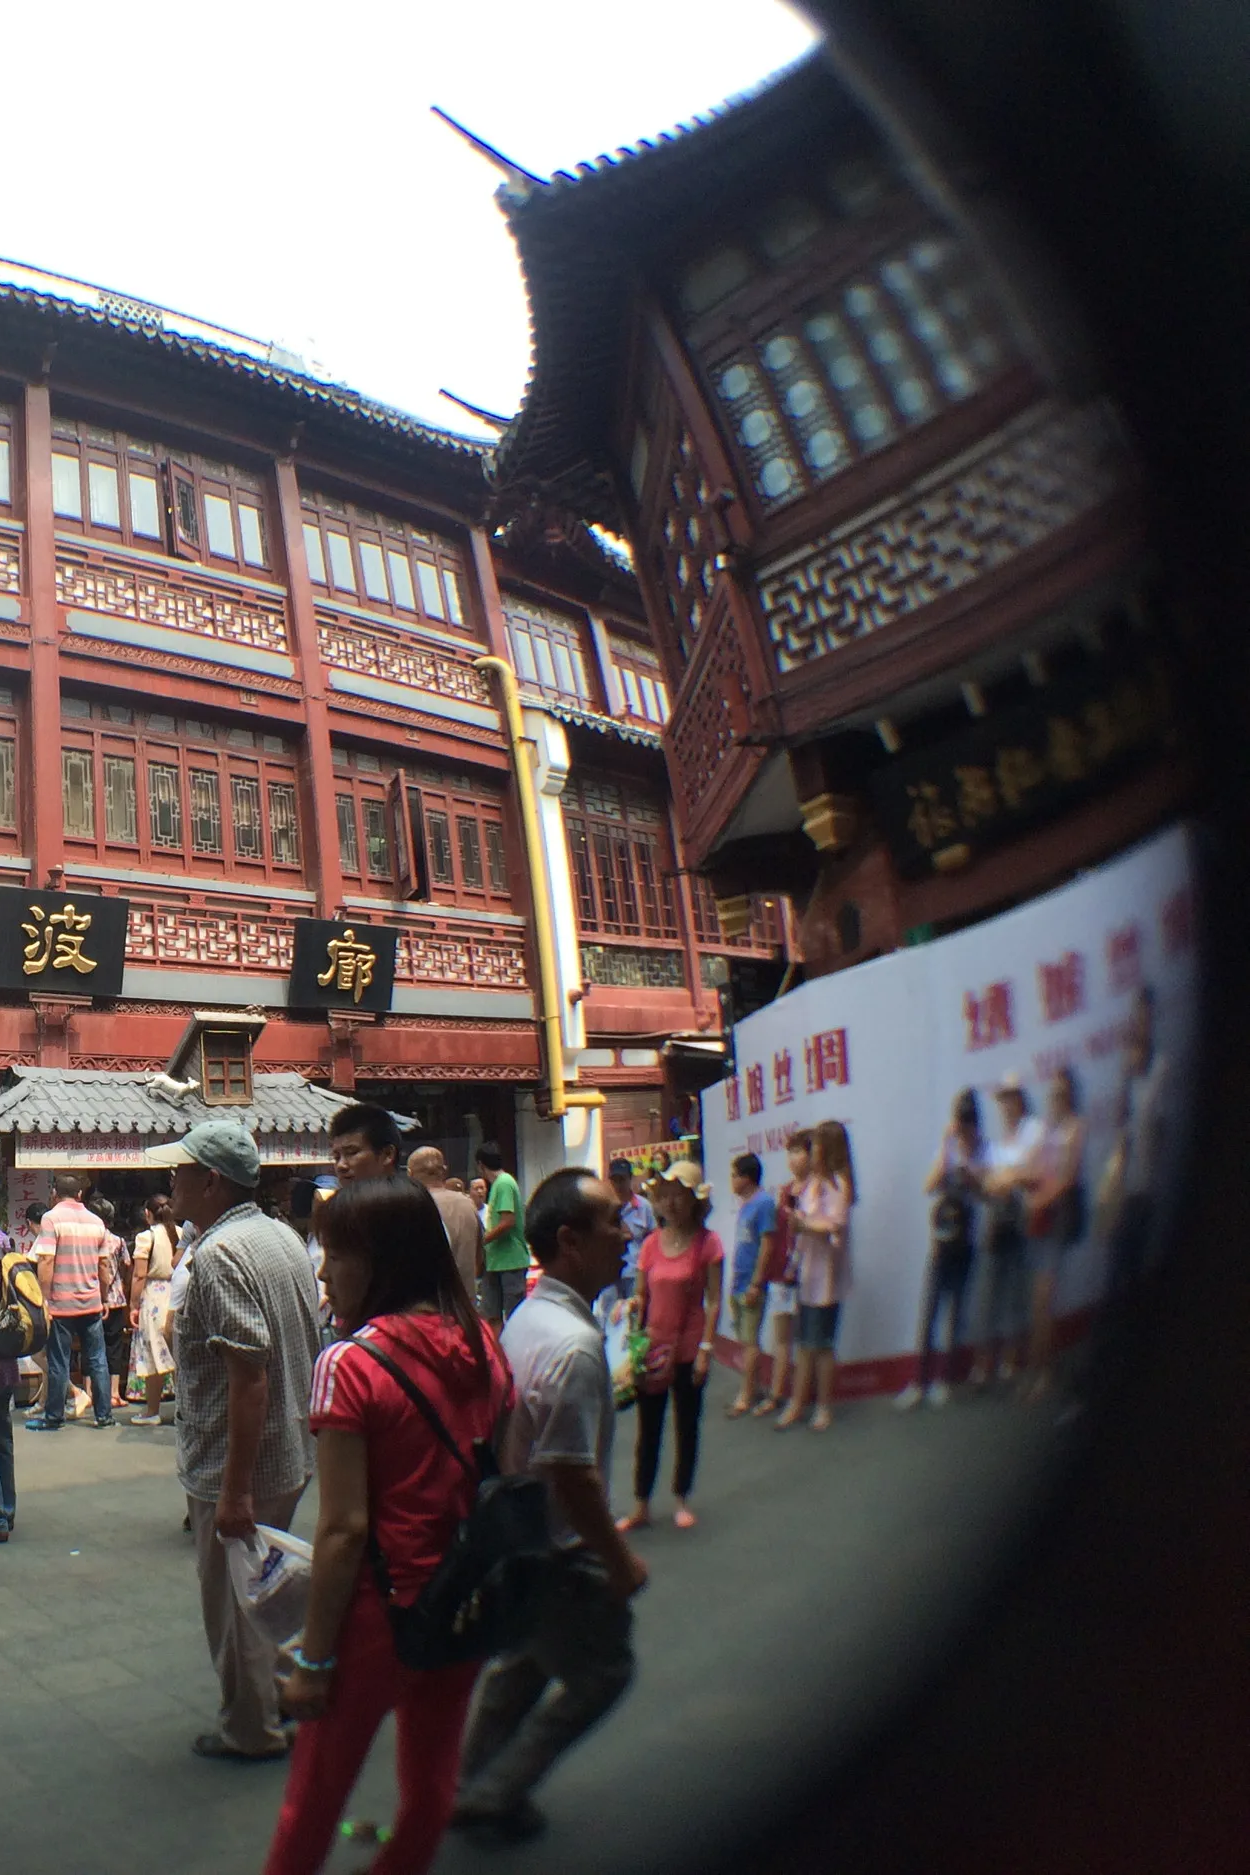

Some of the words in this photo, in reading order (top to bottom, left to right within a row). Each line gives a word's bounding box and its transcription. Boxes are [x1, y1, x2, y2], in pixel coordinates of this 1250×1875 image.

[20, 903, 98, 975] 波
[317, 928, 376, 1004] 廊
[24, 1134, 141, 1150] 新民晚报独家报道
